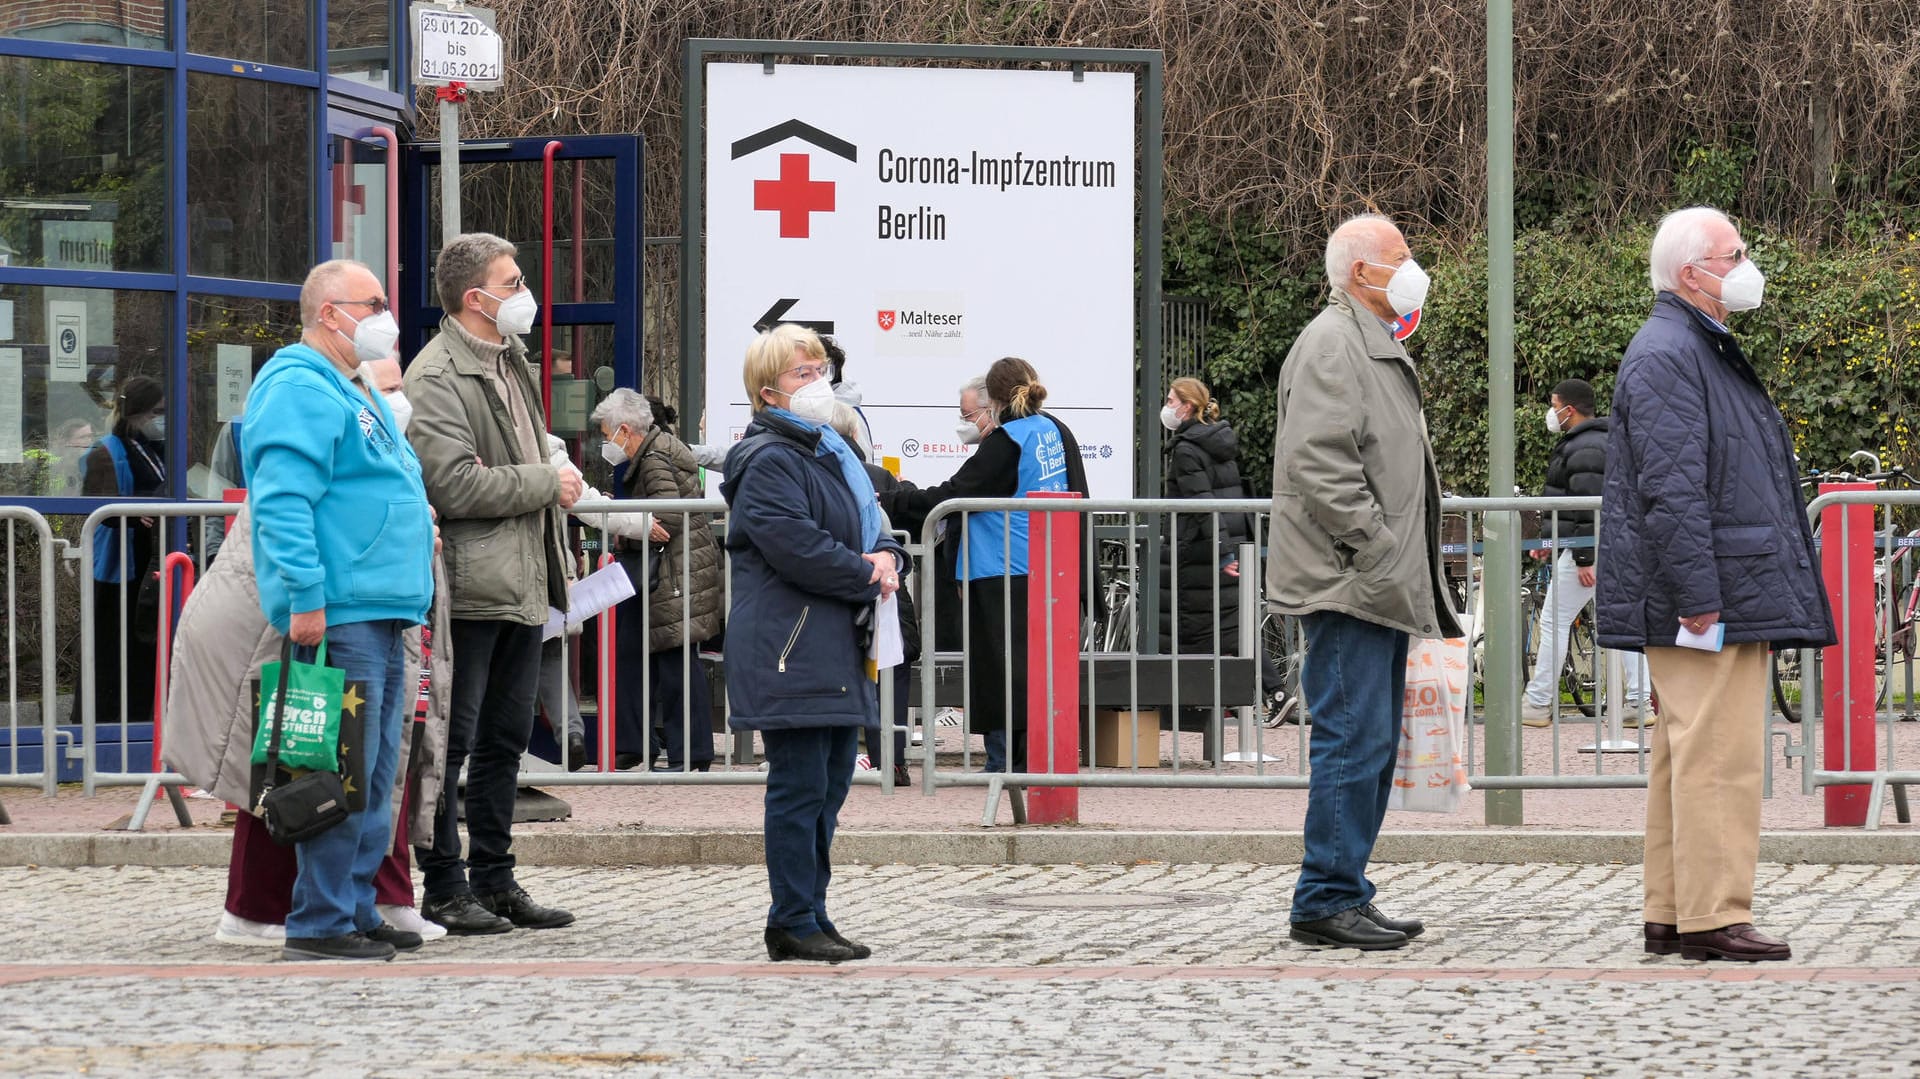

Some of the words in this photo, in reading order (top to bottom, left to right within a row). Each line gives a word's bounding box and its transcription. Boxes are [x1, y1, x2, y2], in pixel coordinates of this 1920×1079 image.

[423, 17, 497, 37] 29.01.202
[447, 41, 467, 56] bis
[423, 59, 496, 78] 31.05.2021
[878, 148, 1116, 192] Corona-Impfzentrum
[878, 205, 946, 240] Berlin
[900, 310, 963, 325] Malteser
[733, 433, 745, 441] BE
[1043, 430, 1057, 443] Wir
[923, 443, 969, 453] BERLIN
[1048, 451, 1066, 470] Berl
[581, 541, 598, 549] BER
[1440, 545, 1454, 553] ER
[1898, 538, 1914, 546] BER
[264, 720, 324, 735] AOTHEKE
